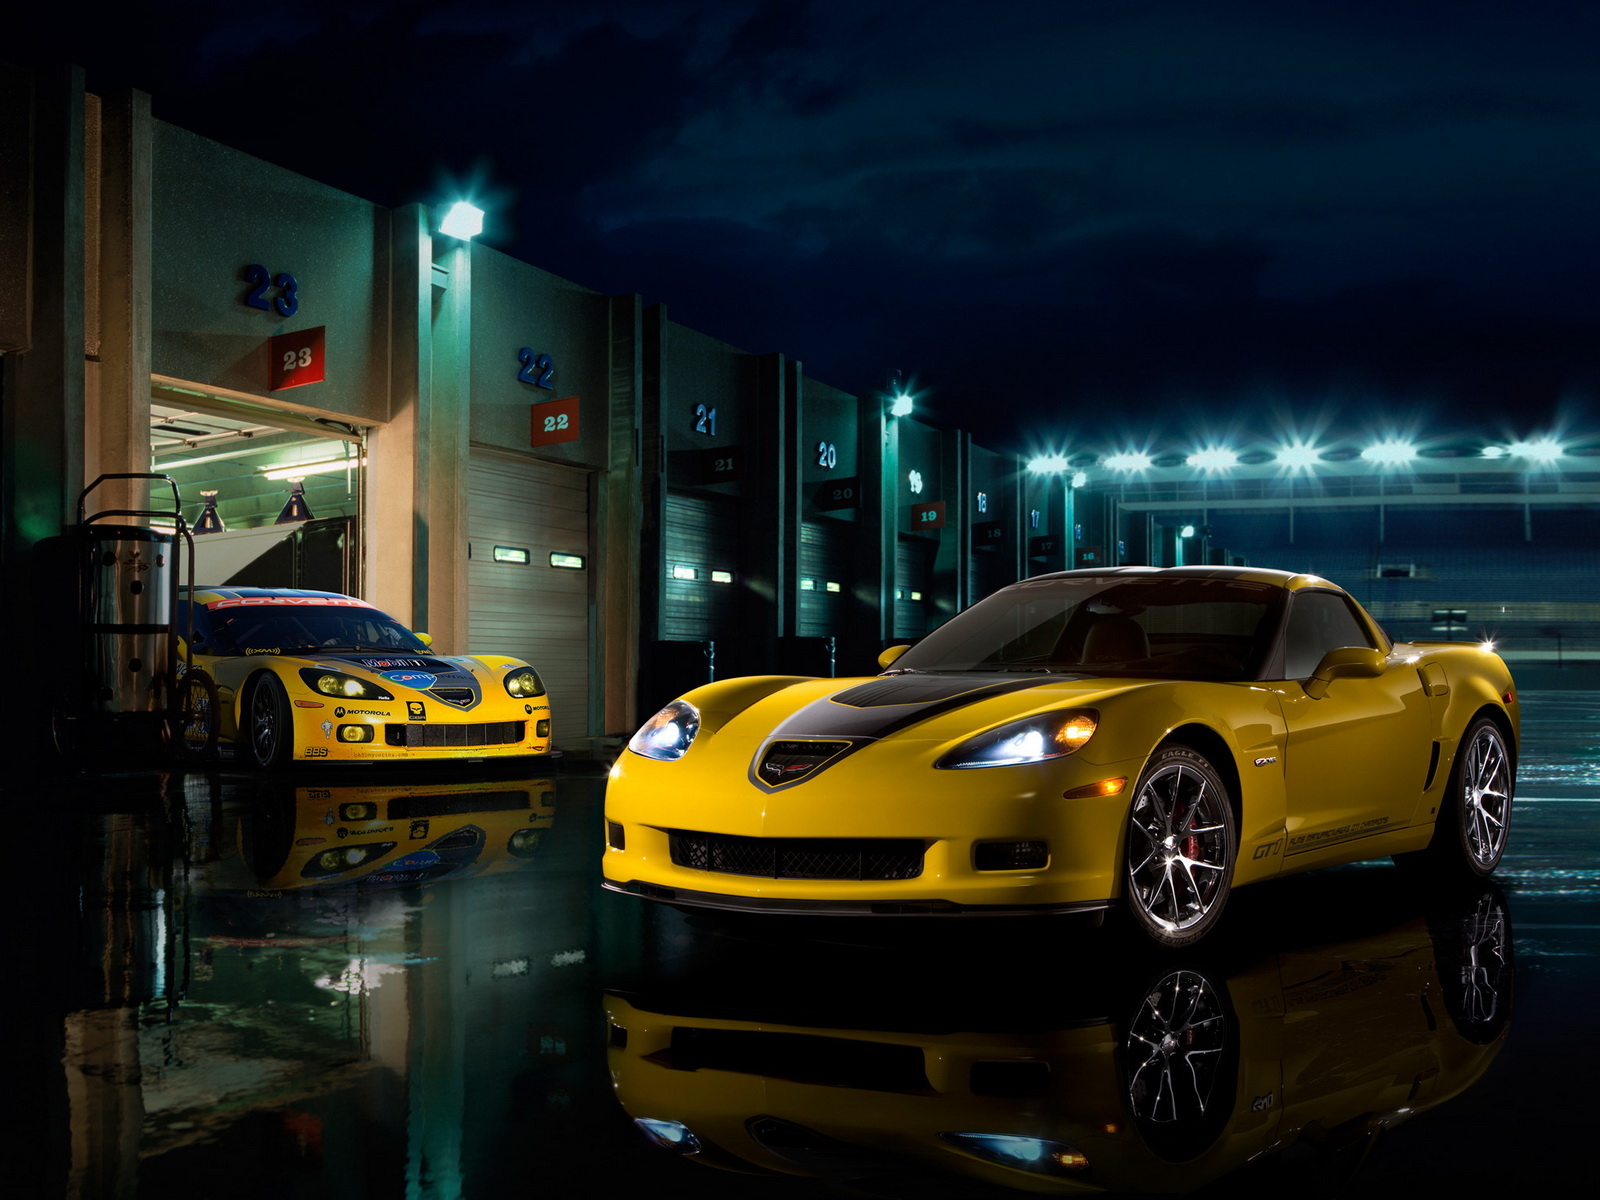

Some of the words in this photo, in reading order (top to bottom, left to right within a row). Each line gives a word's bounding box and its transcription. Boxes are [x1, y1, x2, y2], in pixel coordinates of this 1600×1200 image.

[244, 264, 299, 317] 23
[283, 347, 312, 371] 23
[517, 347, 554, 390] 22
[543, 413, 569, 432] 22
[695, 403, 717, 437] 21
[818, 441, 837, 469] 20
[714, 457, 735, 472] 21
[833, 488, 854, 500] 20
[977, 491, 987, 514] 18
[920, 510, 937, 522] 19
[986, 527, 1002, 539] 18
[1041, 542, 1054, 551] 17
[1082, 551, 1096, 561] 16
[361, 659, 406, 668] Mobil
[305, 747, 328, 757] BBS
[1162, 750, 1194, 760] EAGLE
[1253, 837, 1284, 860] GT1
